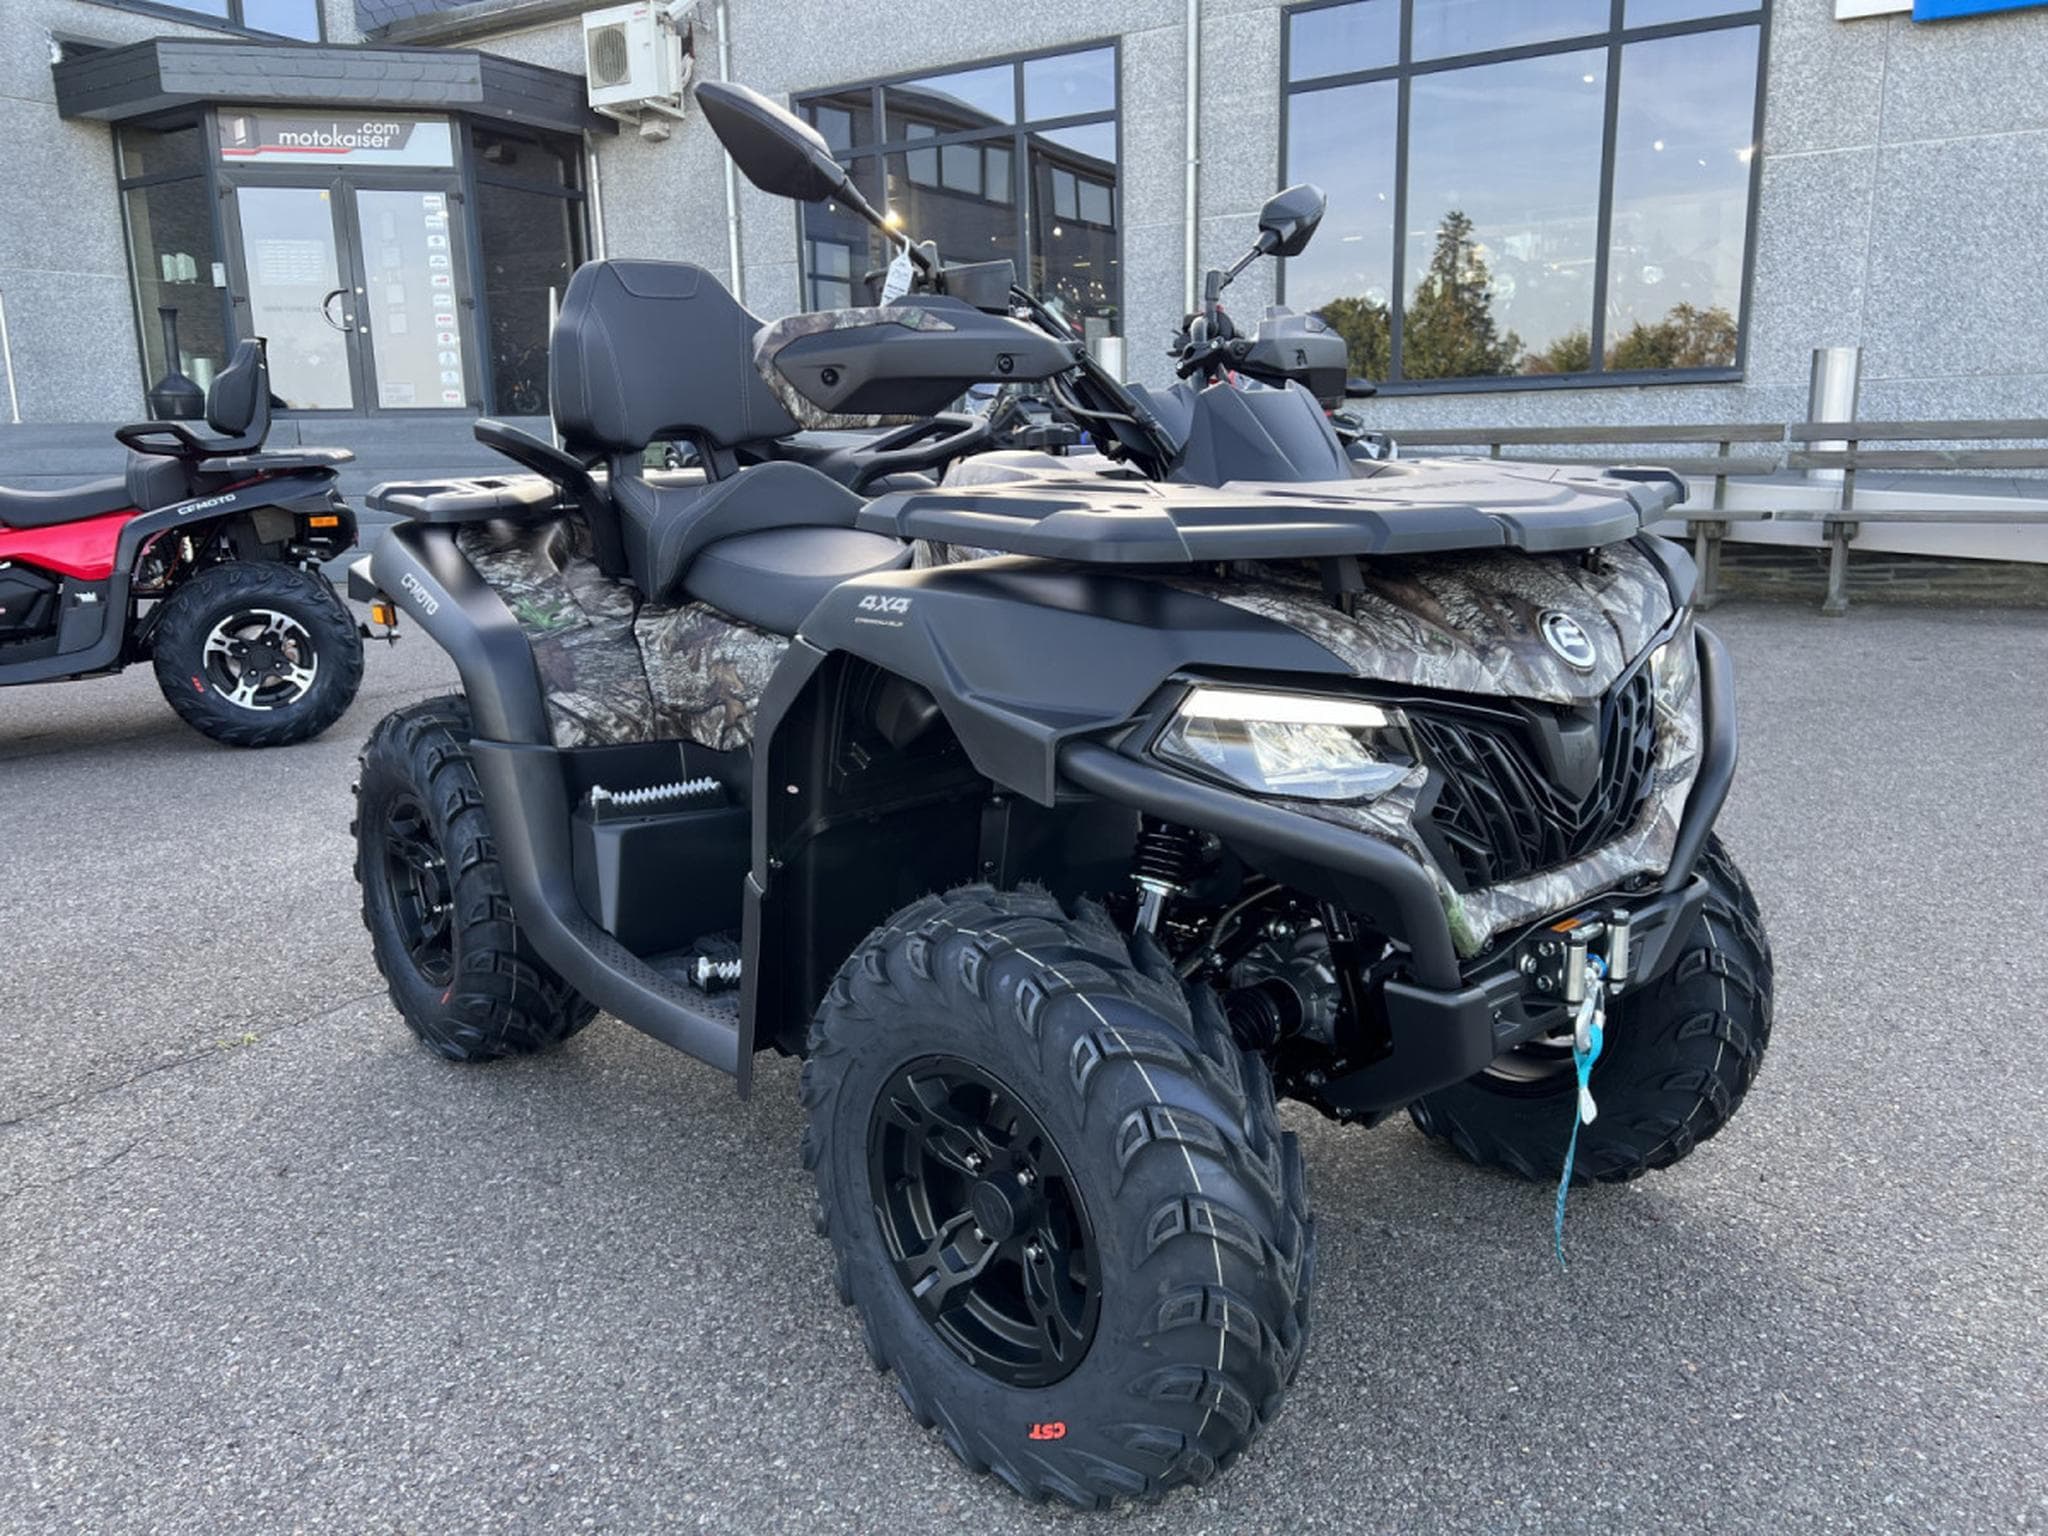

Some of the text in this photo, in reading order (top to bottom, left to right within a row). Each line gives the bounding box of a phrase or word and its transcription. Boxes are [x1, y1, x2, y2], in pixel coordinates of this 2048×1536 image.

[278, 124, 391, 148] motokaiser
[177, 493, 237, 516] CFMOTO
[400, 572, 440, 616] CFMOTO
[1028, 1421, 1066, 1440] CST
